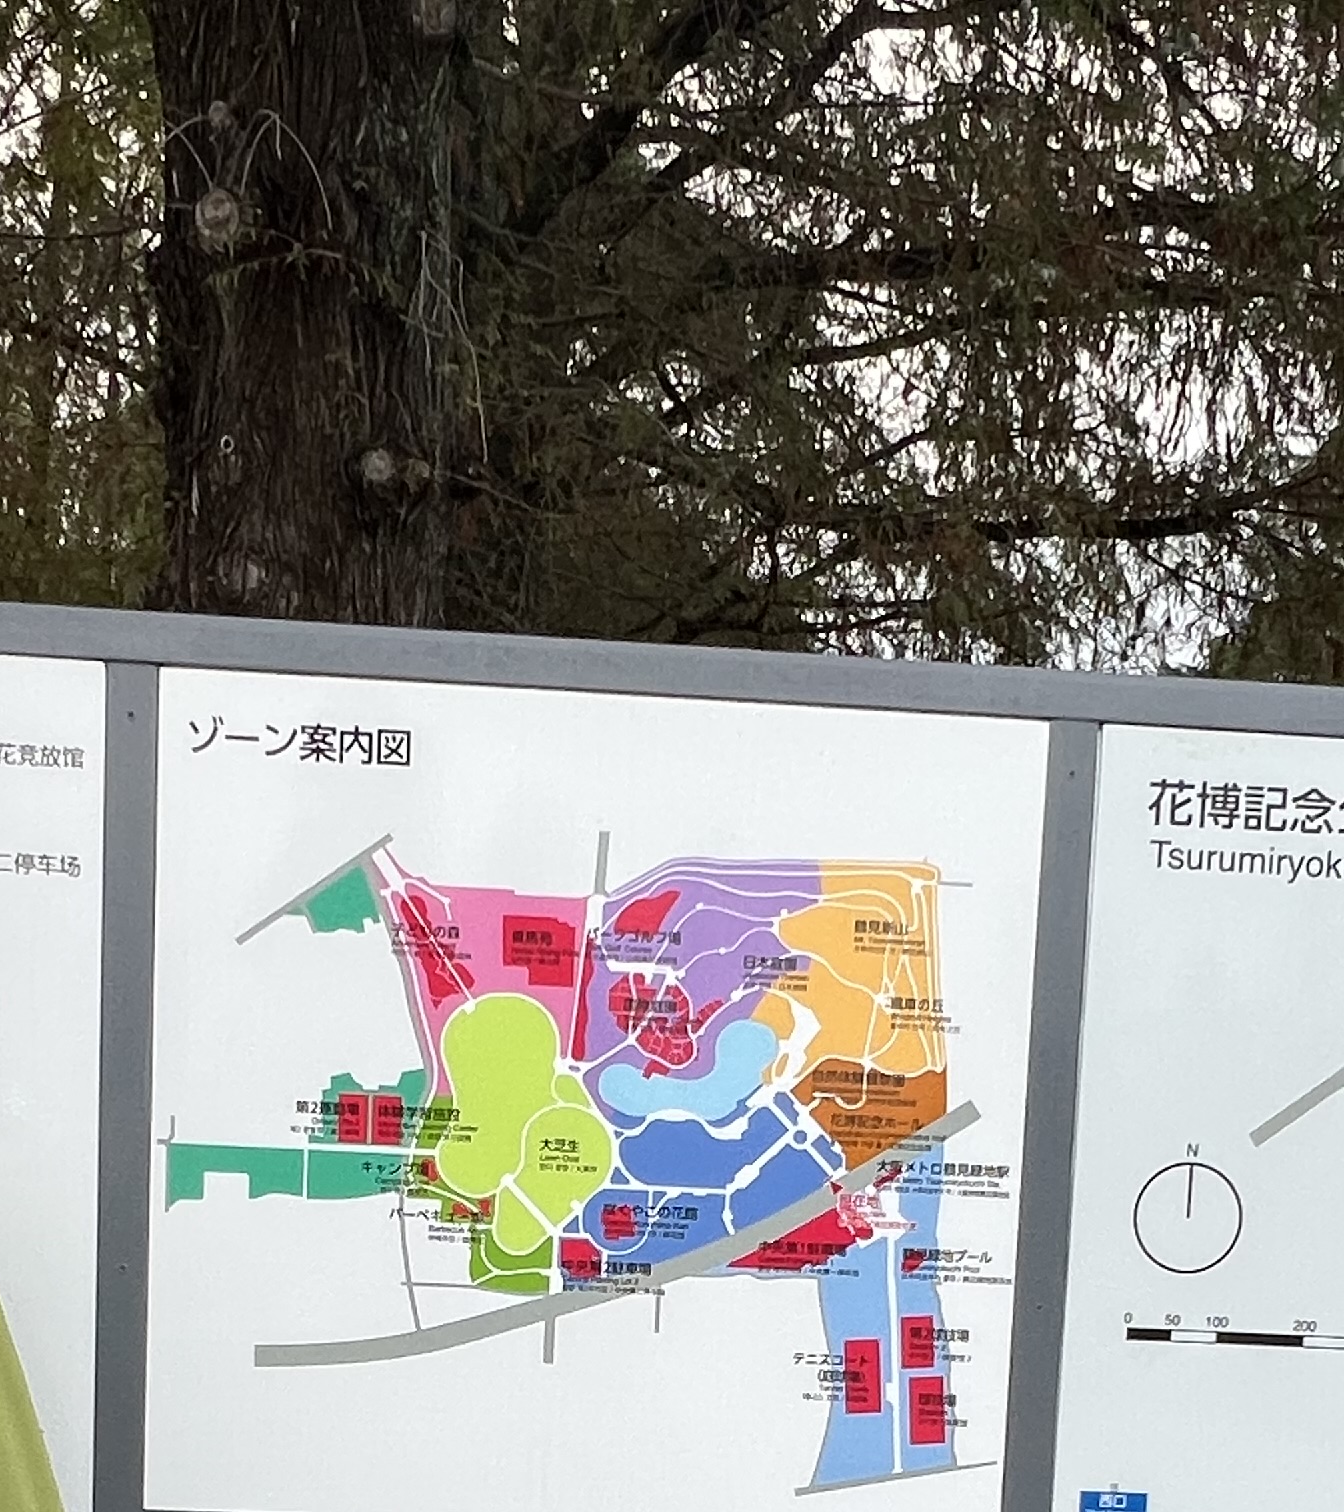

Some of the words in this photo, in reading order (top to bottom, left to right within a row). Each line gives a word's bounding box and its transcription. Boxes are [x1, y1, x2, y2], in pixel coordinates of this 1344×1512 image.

[188, 716, 412, 769] ゾーン案内図
[1186, 1142, 1200, 1158] N
[1123, 1312, 1133, 1325] 0
[1164, 1313, 1182, 1327] 50
[1205, 1314, 1230, 1328] 100
[1292, 1319, 1318, 1333] 200
